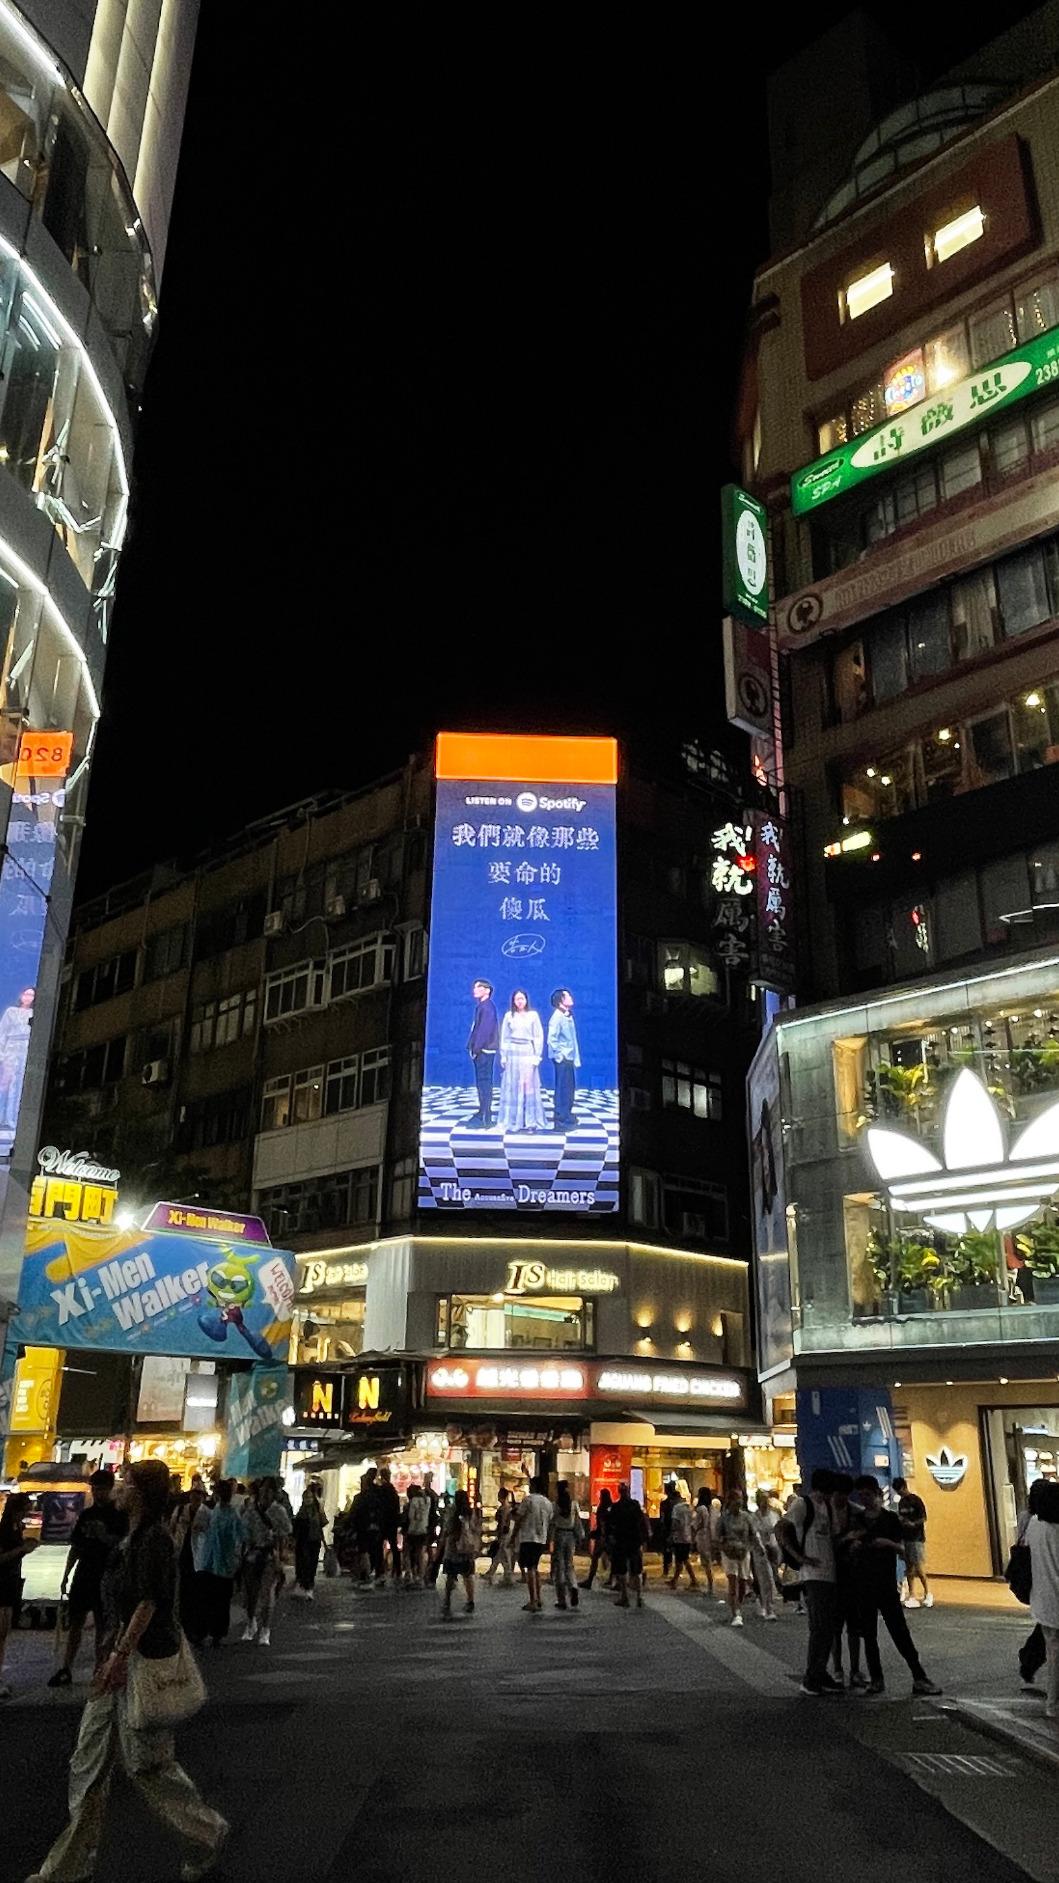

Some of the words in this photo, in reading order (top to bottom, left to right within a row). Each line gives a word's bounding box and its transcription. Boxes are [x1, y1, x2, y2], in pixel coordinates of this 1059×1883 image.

[465, 796, 497, 806] LISTEN
[497, 797, 512, 806] ON
[539, 797, 587, 812] Spotify
[452, 823, 600, 851] 我們就像那些
[499, 897, 550, 921] 傻瓜
[38, 1145, 121, 1182] Welcome
[440, 1182, 472, 1201] The
[518, 1184, 596, 1205] Dreamers
[168, 1209, 207, 1229] Xi-Men
[50, 1252, 156, 1326] Xi-Men
[547, 1269, 577, 1290] Hair
[111, 1261, 209, 1331] Walker
